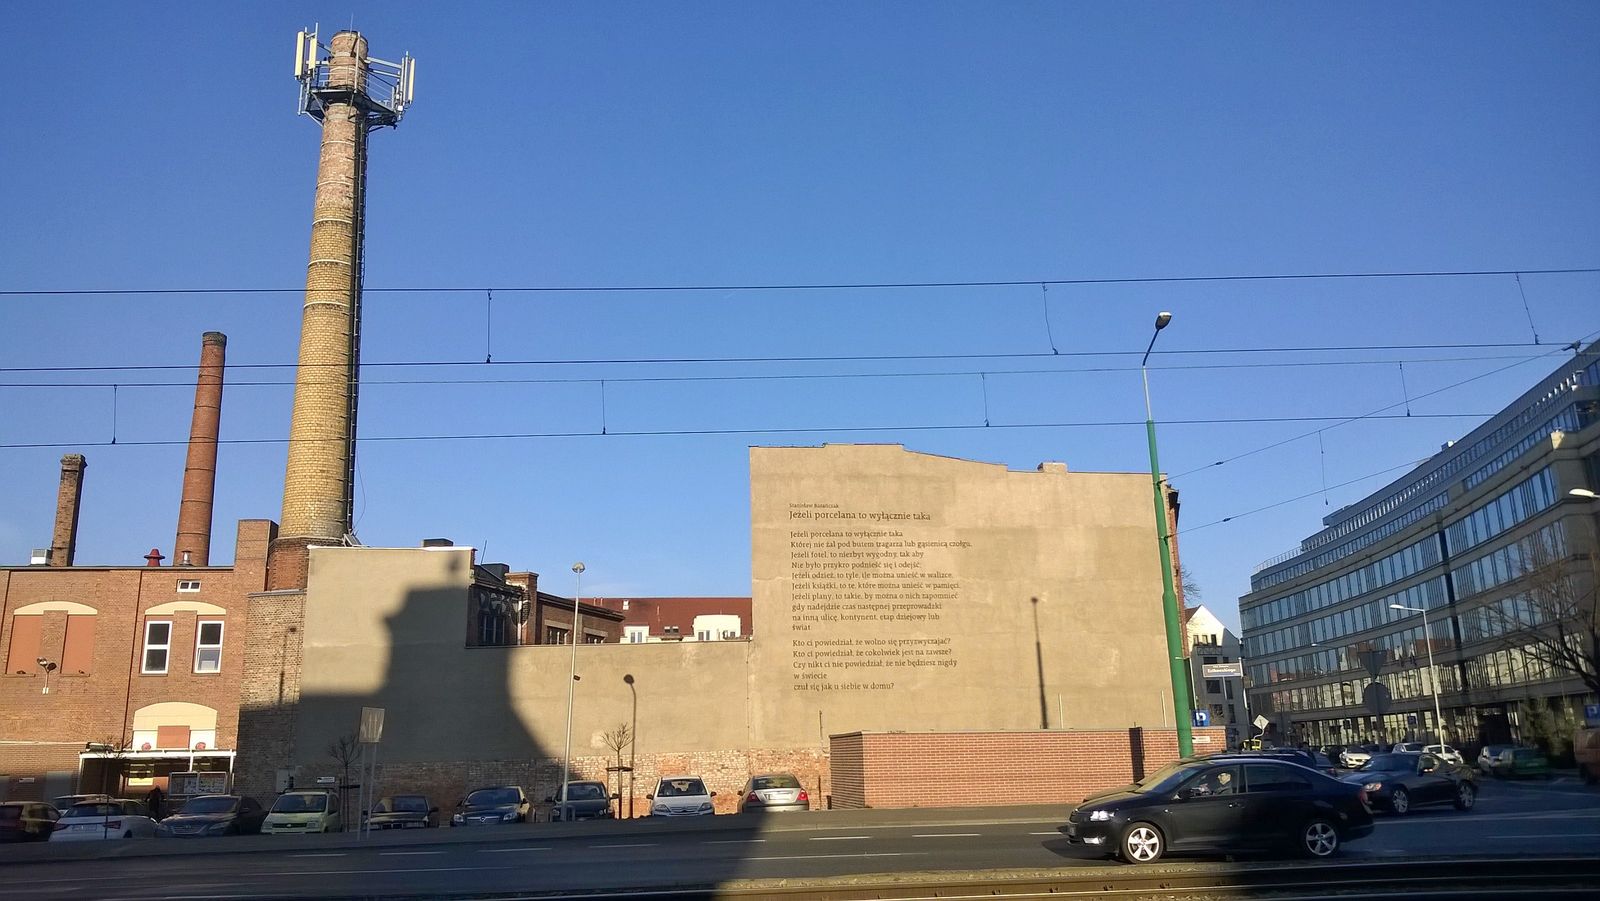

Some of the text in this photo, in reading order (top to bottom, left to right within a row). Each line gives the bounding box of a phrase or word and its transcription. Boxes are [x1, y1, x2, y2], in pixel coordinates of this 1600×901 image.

[789, 511, 812, 521] Jeżeli
[814, 511, 856, 521] porcelana
[868, 512, 911, 522] wyłącznie
[913, 512, 931, 520] taka
[790, 530, 809, 539] Jeżeli
[810, 530, 844, 539] porcelana
[853, 530, 888, 539] wyłącznie
[790, 540, 812, 549] Której
[813, 540, 825, 548] nie
[826, 540, 836, 548] żal
[837, 540, 851, 549] pod
[851, 540, 876, 548] butem
[875, 541, 903, 549] tragarza
[904, 540, 916, 548] lub
[917, 540, 948, 549] gąsienicą
[791, 551, 810, 560] Jeżeli
[838, 551, 865, 560] niezbyt
[899, 550, 911, 558] tak
[912, 550, 924, 559] aby
[791, 561, 804, 569] Nie
[805, 561, 822, 570] było
[822, 561, 850, 570] przykro
[851, 561, 882, 570] podnieść
[883, 561, 893, 570] się
[792, 571, 811, 580] Jeżeli
[861, 571, 871, 579] ile
[872, 571, 895, 579] można
[896, 571, 919, 579] unieść
[792, 582, 811, 591] Jeżeli
[877, 581, 900, 589] można
[901, 581, 924, 589] unieść
[792, 592, 811, 602] Jeżeli
[875, 592, 898, 600] można
[905, 592, 921, 600] nich
[792, 603, 806, 612] gdy
[807, 603, 841, 612] nadejdzie
[857, 603, 891, 612] następnej
[892, 602, 943, 612] przeprowadzki
[802, 614, 819, 623] inną
[879, 614, 895, 622] etap
[895, 613, 927, 622] dziejowy
[888, 638, 898, 647] się
[898, 637, 951, 647] przyzwyczajać?
[901, 648, 914, 658] jest
[925, 648, 952, 656] zawsze?
[793, 660, 807, 669] Czy
[807, 660, 823, 668] nikt
[894, 659, 906, 667] nie
[907, 659, 936, 668] będziesz
[937, 659, 957, 668] nigdy
[810, 683, 820, 692] się
[821, 683, 833, 692] jak
[840, 682, 861, 690] siebie
[870, 682, 895, 690] domu?
[1587, 706, 1597, 718] P
[1196, 712, 1207, 725] P
